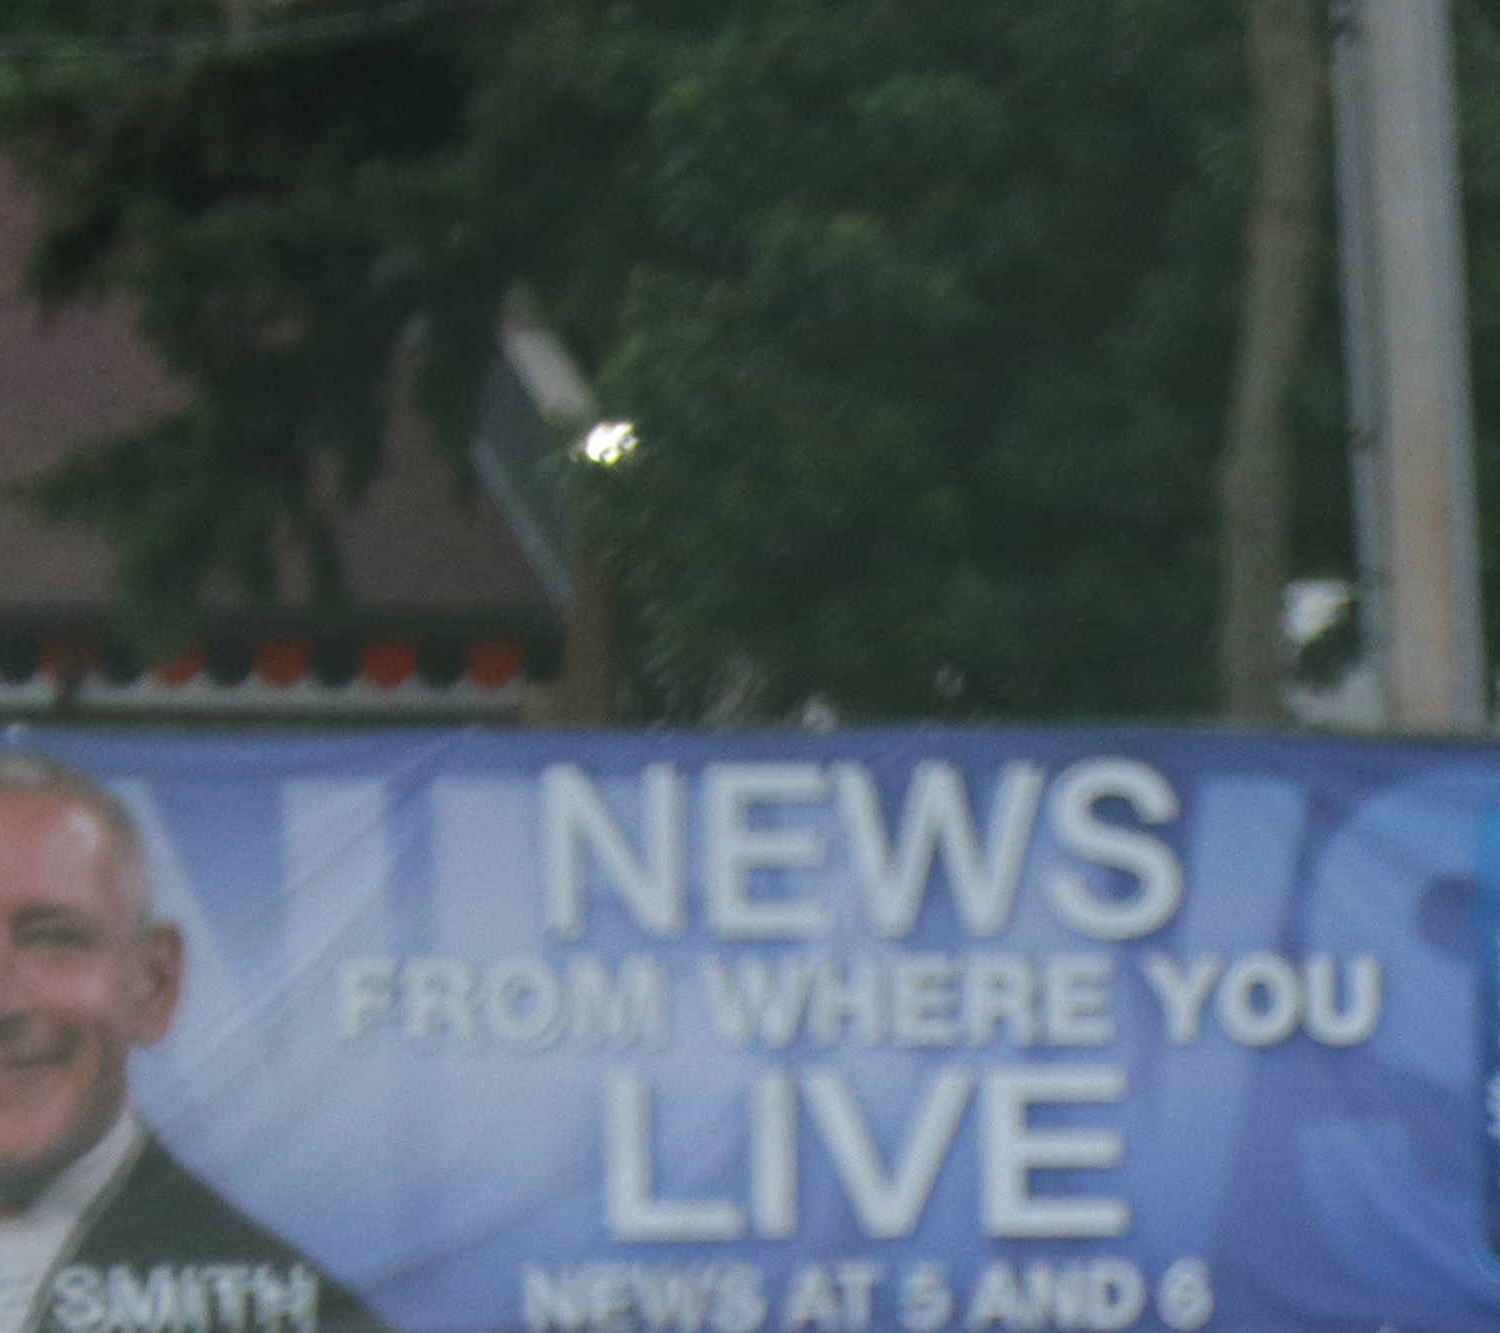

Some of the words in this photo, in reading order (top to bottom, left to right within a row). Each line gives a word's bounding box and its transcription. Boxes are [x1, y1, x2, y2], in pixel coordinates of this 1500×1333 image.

[537, 757, 1186, 942] NEWS
[334, 954, 670, 1054] FROM
[709, 952, 1118, 1052] WHERE
[1145, 952, 1385, 1049] YOU
[604, 1064, 1136, 1244] LIVE
[966, 1257, 1147, 1333] AND
[1157, 1256, 1215, 1333] 6
